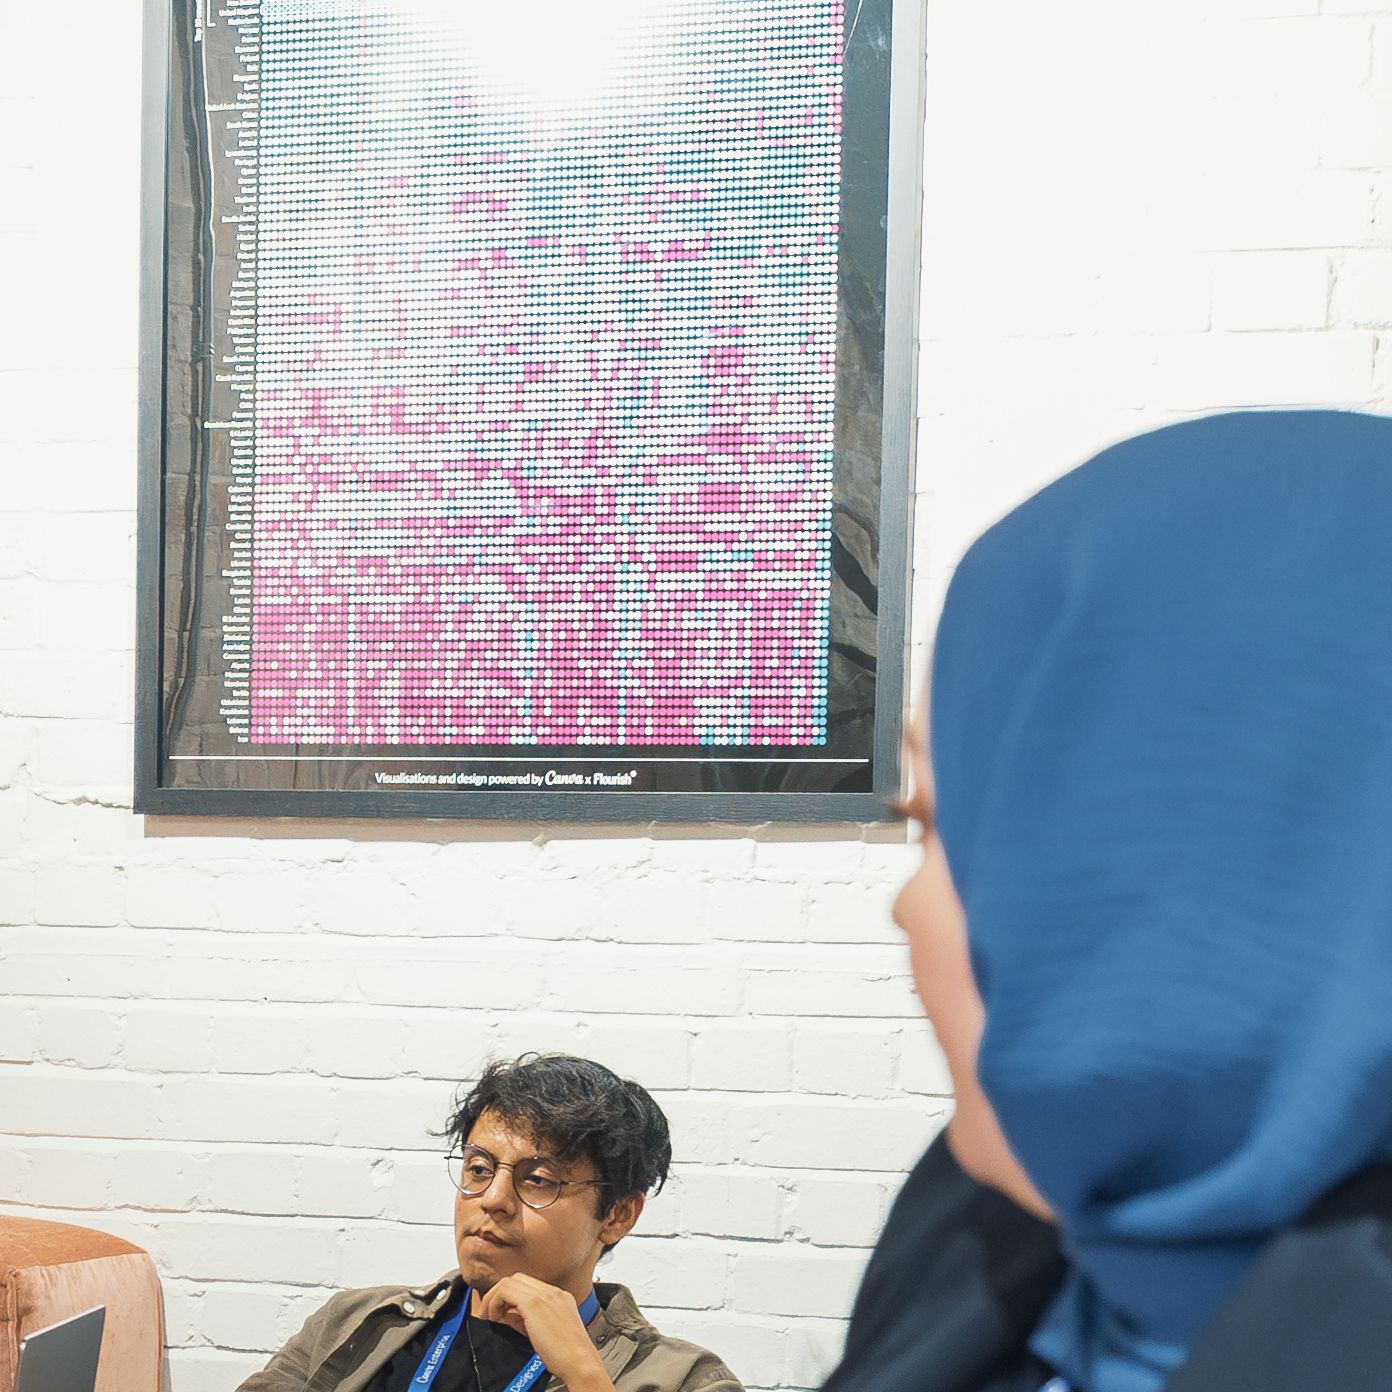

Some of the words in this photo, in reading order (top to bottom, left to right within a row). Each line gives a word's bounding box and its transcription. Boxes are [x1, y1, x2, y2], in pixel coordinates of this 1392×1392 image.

[375, 773, 437, 784] Visualisations
[438, 773, 456, 784] and
[457, 773, 488, 786] design
[488, 773, 531, 786] powered
[531, 773, 544, 786] by
[545, 770, 584, 786] Canva
[585, 776, 592, 785] x
[593, 772, 632, 785] Flourish
